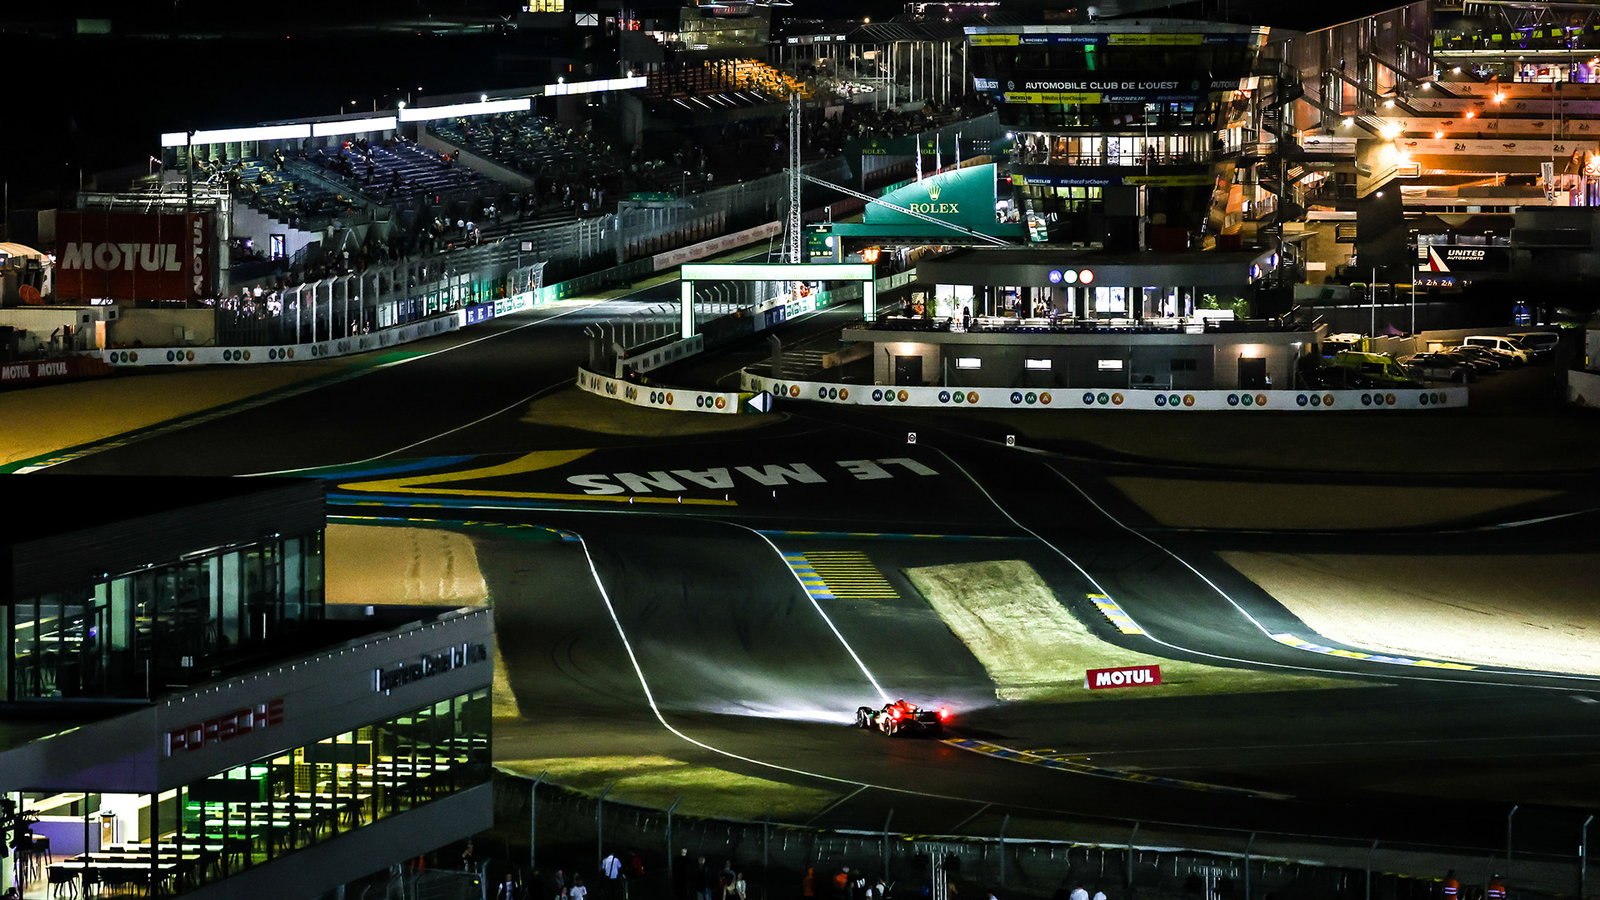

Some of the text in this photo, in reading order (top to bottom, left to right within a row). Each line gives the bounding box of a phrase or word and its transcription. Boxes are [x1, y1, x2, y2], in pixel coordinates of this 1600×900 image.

[1089, 82, 1119, 90] CLUB
[1121, 82, 1135, 90] DE
[1138, 81, 1179, 90] L'OUEST
[909, 203, 959, 214] ROLEX
[61, 242, 182, 272] MOTUL
[192, 217, 203, 296] MOTUL
[2, 362, 67, 380] MOTUL MOTUL
[872, 390, 908, 401] MMA
[939, 392, 978, 402] MMA
[1011, 393, 1051, 403] MMA
[1083, 393, 1123, 404] MMA
[1155, 395, 1194, 405] MMA
[1227, 395, 1266, 405] MMA
[566, 457, 940, 495] LE MANS
[1096, 669, 1154, 686] MOTUL
[166, 699, 284, 757] PORSCHE
